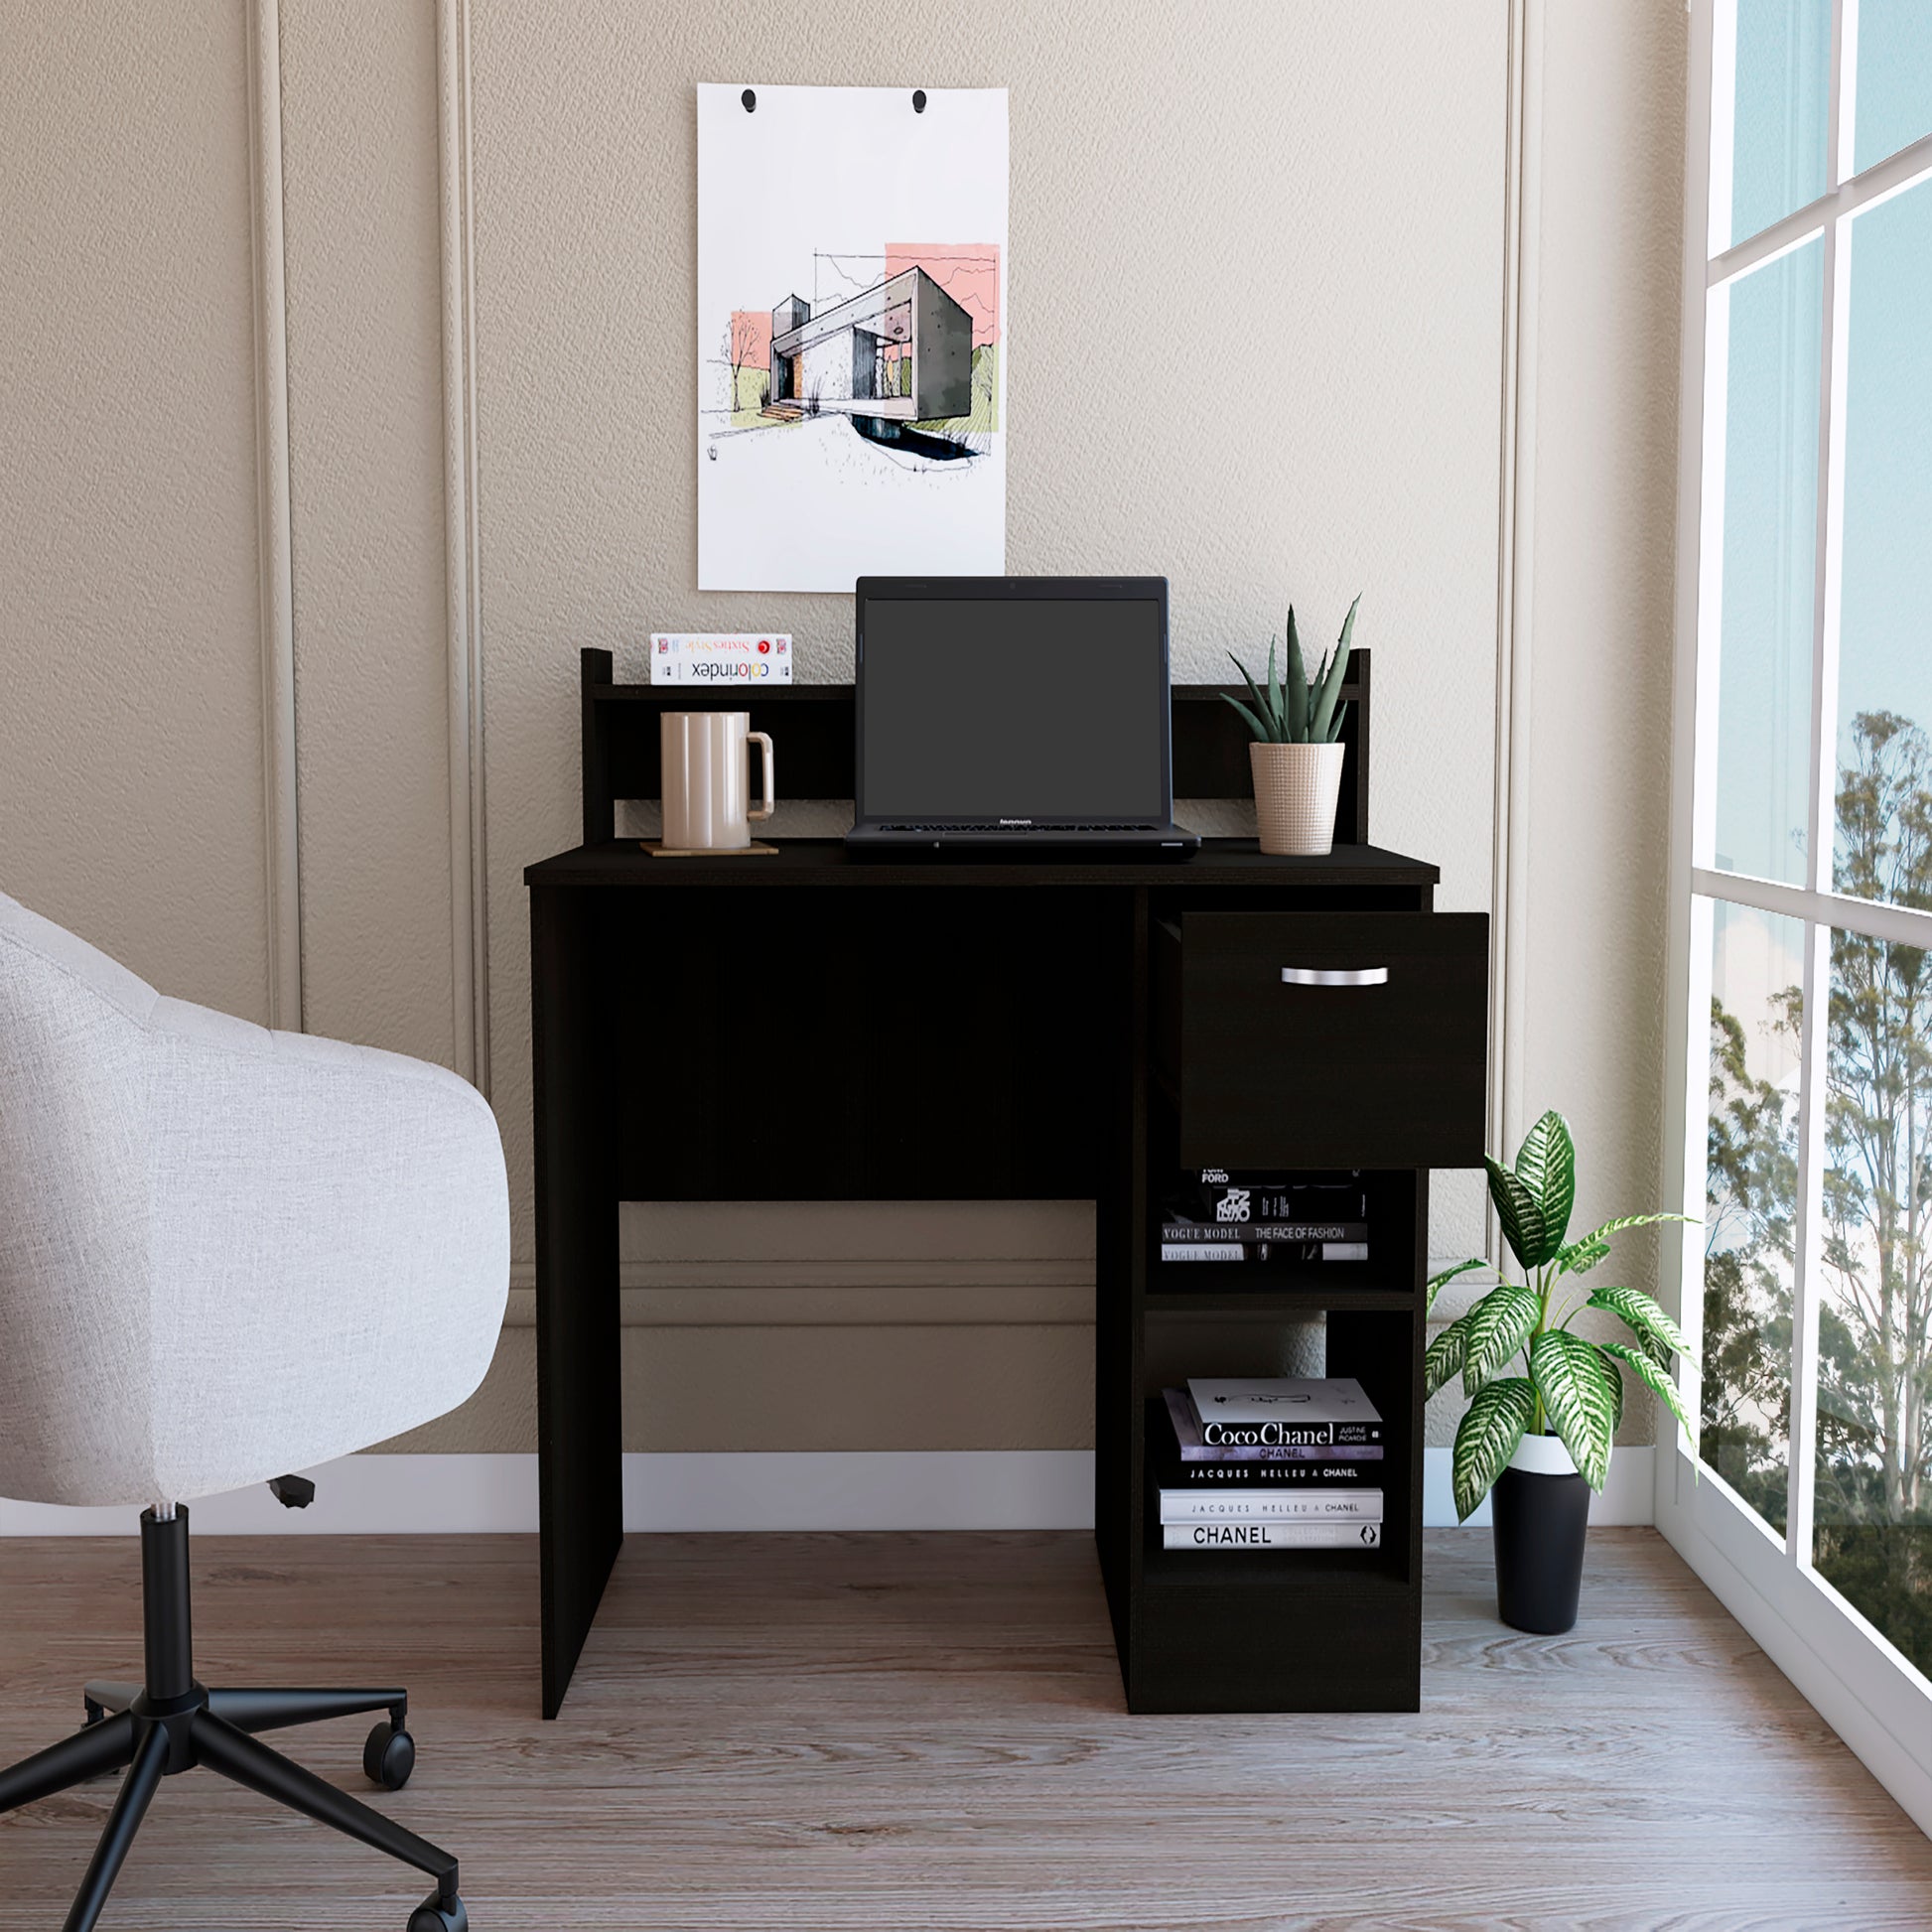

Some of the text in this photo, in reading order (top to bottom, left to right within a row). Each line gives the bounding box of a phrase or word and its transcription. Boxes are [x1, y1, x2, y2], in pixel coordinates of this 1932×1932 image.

[692, 662, 768, 681] colorindex
[1201, 1173, 1229, 1183] FORD
[1164, 1227, 1344, 1240] VOGUE MODEL THE FACE OF FASHION
[1164, 1249, 1240, 1261] VOGUE MODEL
[1259, 1448, 1306, 1458] CHANEL
[1190, 1469, 1249, 1478] JACQUES
[1261, 1469, 1307, 1478] HELLEU
[1322, 1467, 1358, 1477] CHANEL
[1191, 1504, 1250, 1513] JACQUES
[1324, 1503, 1360, 1512] CHANEL
[1193, 1526, 1272, 1544] CHANEL
